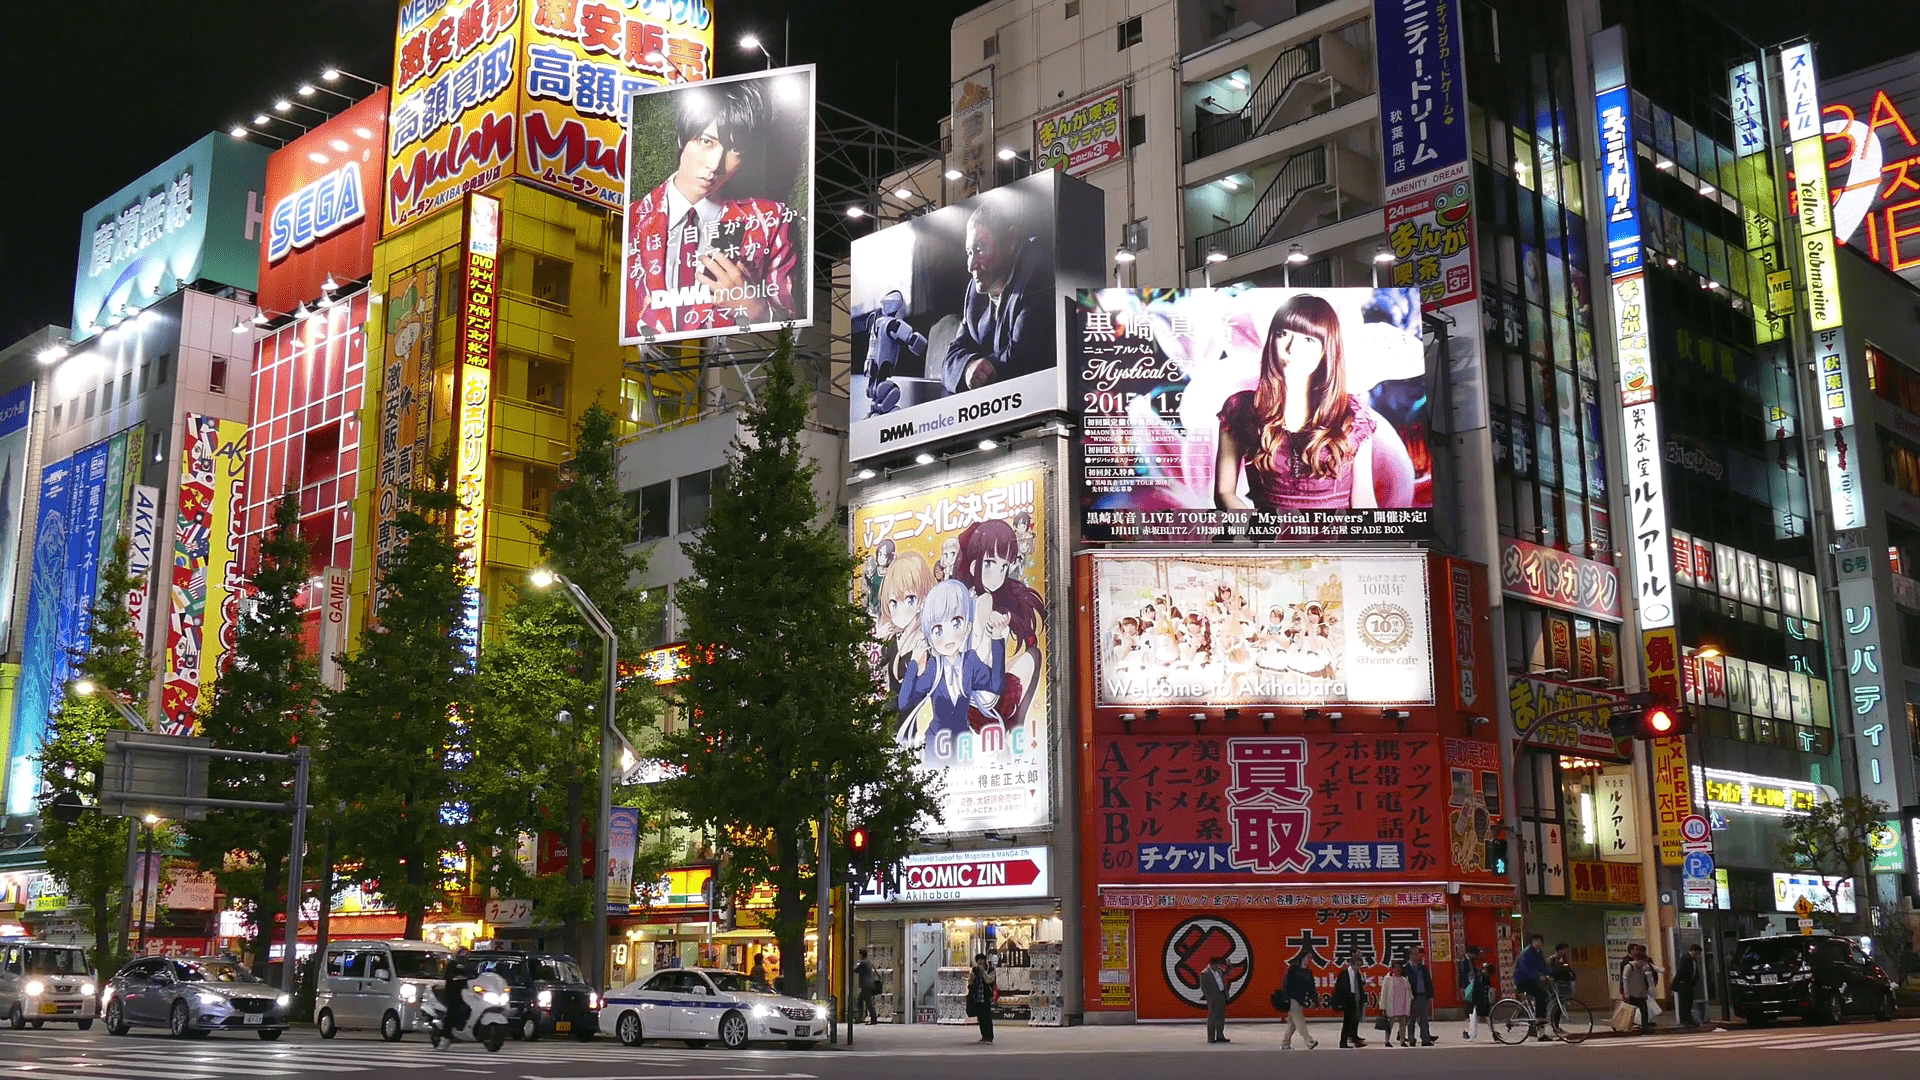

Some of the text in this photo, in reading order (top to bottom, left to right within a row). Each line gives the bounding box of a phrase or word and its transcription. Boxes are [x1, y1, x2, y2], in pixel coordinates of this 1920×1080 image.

[391, 36, 514, 155] 高額買取
[1038, 97, 1118, 148] まんが喫茶
[1069, 120, 1117, 150] ゲラゲラ
[1390, 110, 1406, 173] 秋葉原店
[390, 112, 514, 223] Mulan
[1391, 166, 1464, 197] AMENITY DREAM
[543, 168, 627, 208] ムーラン AKI
[269, 164, 365, 262] SEGA
[399, 198, 433, 225] ムーラン
[434, 186, 462, 208] AKIBA
[90, 172, 196, 278] 廣瀬無線
[1389, 221, 1469, 258] まんが
[472, 254, 493, 270] DVD
[1800, 178, 1830, 320] Yellow Submarine
[469, 279, 492, 294] ゲーム
[472, 292, 488, 304] CD
[651, 281, 780, 311] DMM mobile
[467, 316, 491, 330] アニメ
[468, 304, 491, 318] アイドル
[684, 304, 749, 325] のスマホ
[467, 329, 489, 343] コミック
[1083, 344, 1154, 356] ニューアルバム
[1820, 330, 1837, 343] 5F
[466, 353, 488, 367] フィギュア
[1082, 356, 1167, 392] Mystical
[958, 391, 1023, 423] ROBOTS
[1512, 445, 1532, 475] 5F
[131, 490, 154, 562] AKKY
[1086, 512, 1137, 524] 黒崎真音
[1141, 512, 1175, 524] LIVE
[1178, 512, 1217, 524] TOUR
[1221, 512, 1248, 524] 2016
[1351, 525, 1383, 535] SPADE
[1384, 525, 1405, 535] BOX
[1672, 536, 1714, 584] 買取
[1841, 555, 1869, 573] 6号
[1502, 543, 1618, 612] メイドカジノ
[329, 574, 346, 625] GAME
[1371, 619, 1392, 633] 10
[1396, 656, 1419, 666] cafe
[1107, 677, 1347, 698] Welcome to Akihabara
[1464, 672, 1473, 699] 入口
[1845, 605, 1884, 785] リバティー
[978, 769, 1039, 789] 得能正太郎
[990, 758, 1037, 771] ニューゲーム
[1165, 741, 1193, 812] アニメ
[1344, 740, 1370, 812] ホビー
[1136, 741, 1165, 838] アイドル
[1193, 740, 1223, 841] 美少女系
[1316, 741, 1344, 840] フィギュア
[1375, 740, 1405, 840] 携帯電話
[1102, 740, 1133, 871] AKBもの
[1224, 737, 1317, 875] 買取
[1405, 741, 1437, 872] アップルとか
[1610, 790, 1627, 852] ルノアール
[1687, 822, 1704, 835] 40
[1140, 844, 1401, 872] チケット 大黒屋
[1690, 858, 1702, 876] P
[907, 862, 1006, 888] COMIC ZIN
[906, 889, 961, 901] Akihabara
[491, 902, 531, 921] ラーメン
[1316, 908, 1391, 925] チケット
[1285, 928, 1425, 970] 大黒屋
